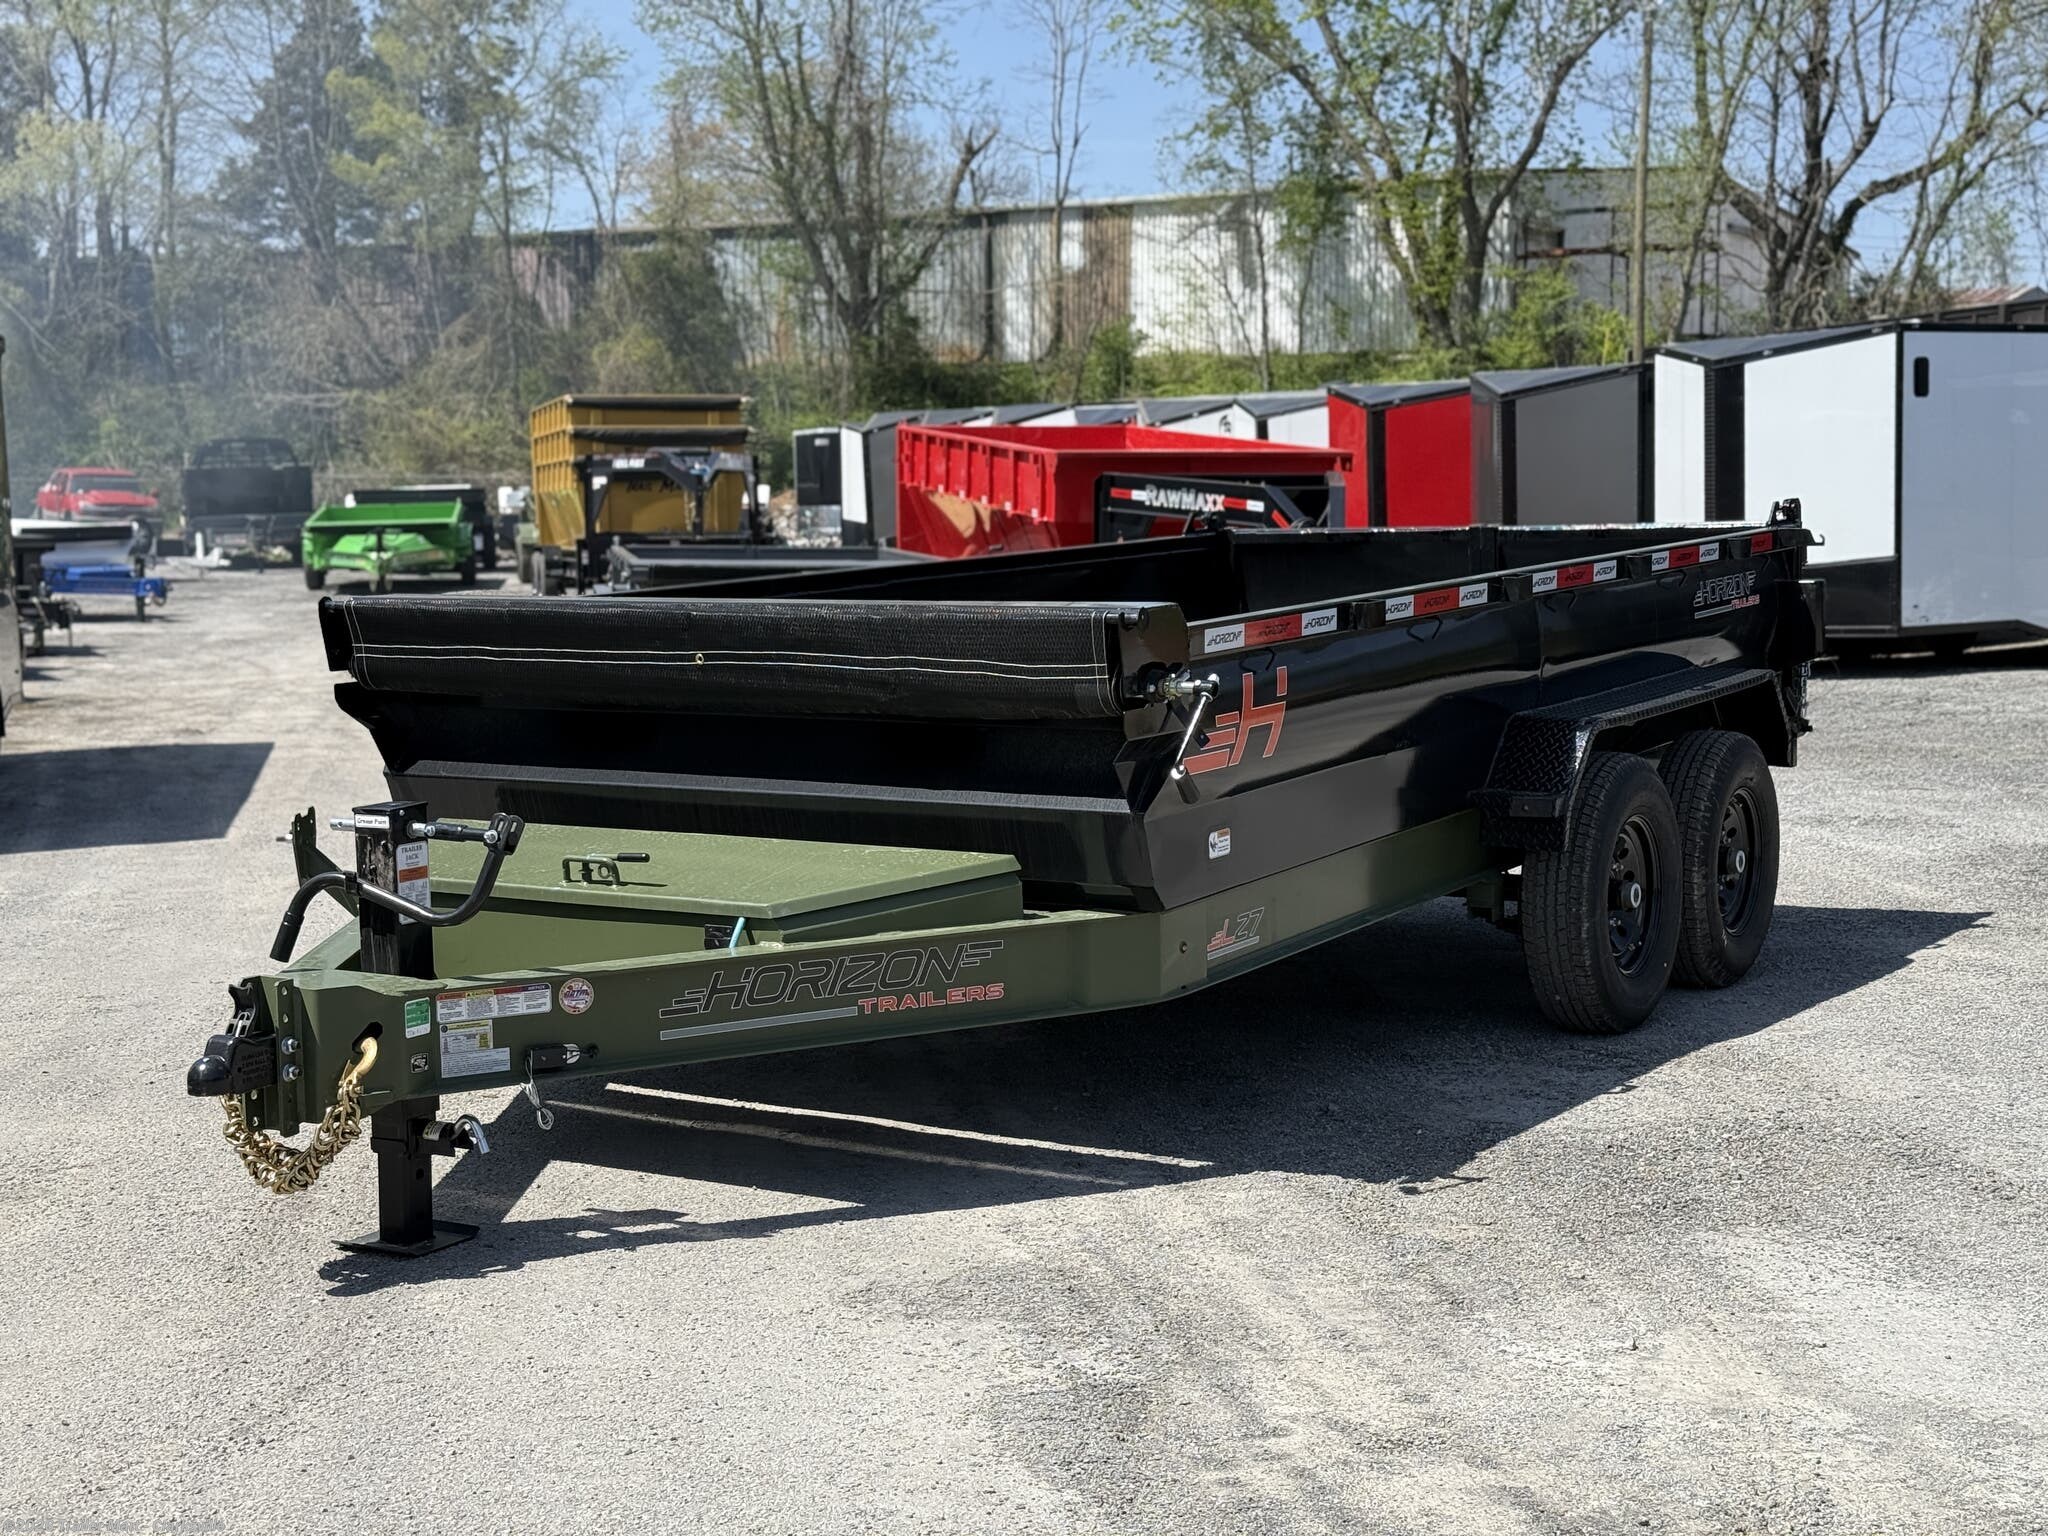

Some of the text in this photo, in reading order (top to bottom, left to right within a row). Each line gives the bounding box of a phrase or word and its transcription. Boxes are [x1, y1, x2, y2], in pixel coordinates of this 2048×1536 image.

[1694, 571, 1756, 607] HORIZON
[1303, 614, 1336, 629] HORIZON
[1206, 630, 1243, 646] HORIZON
[401, 844, 423, 854] TRAILER
[405, 854, 419, 862] JACK
[672, 940, 990, 1016] HORIZON
[857, 982, 1006, 1015] TRAILERS
